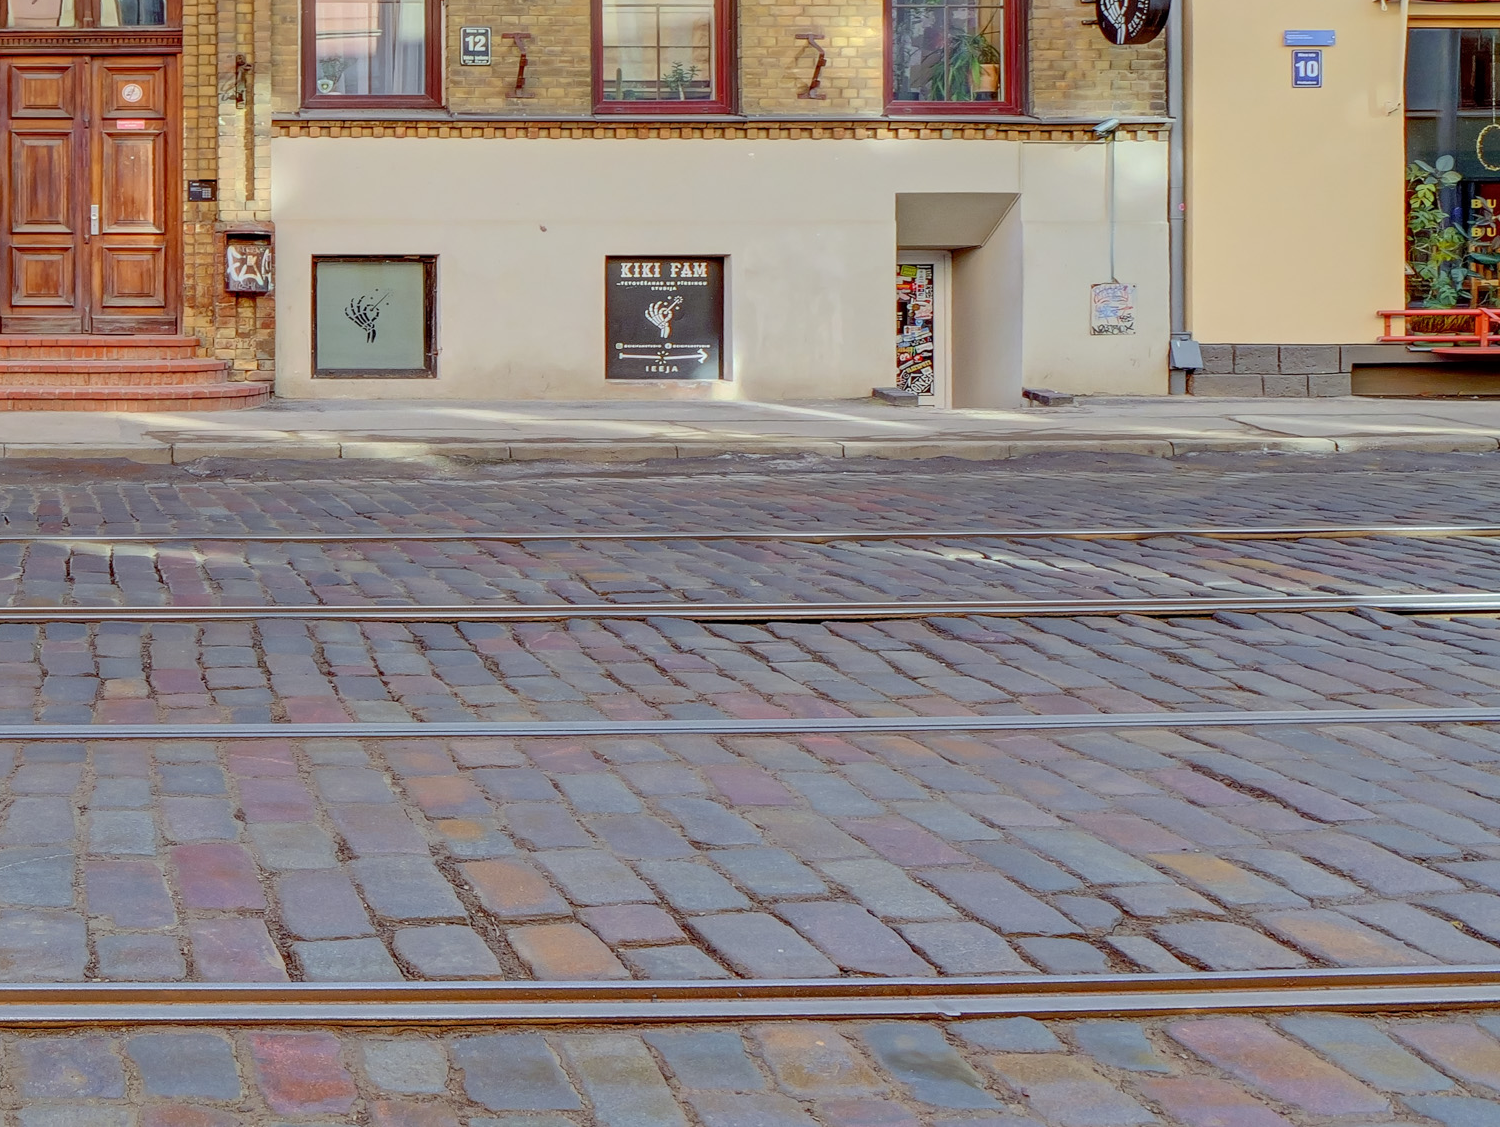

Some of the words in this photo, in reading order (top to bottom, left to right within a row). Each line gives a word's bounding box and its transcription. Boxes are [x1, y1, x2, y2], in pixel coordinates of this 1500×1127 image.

[465, 35, 486, 51] 12
[1295, 60, 1319, 77] 10
[620, 262, 661, 278] KIKI
[670, 262, 708, 278] FAM
[645, 365, 679, 373] IEEJA
